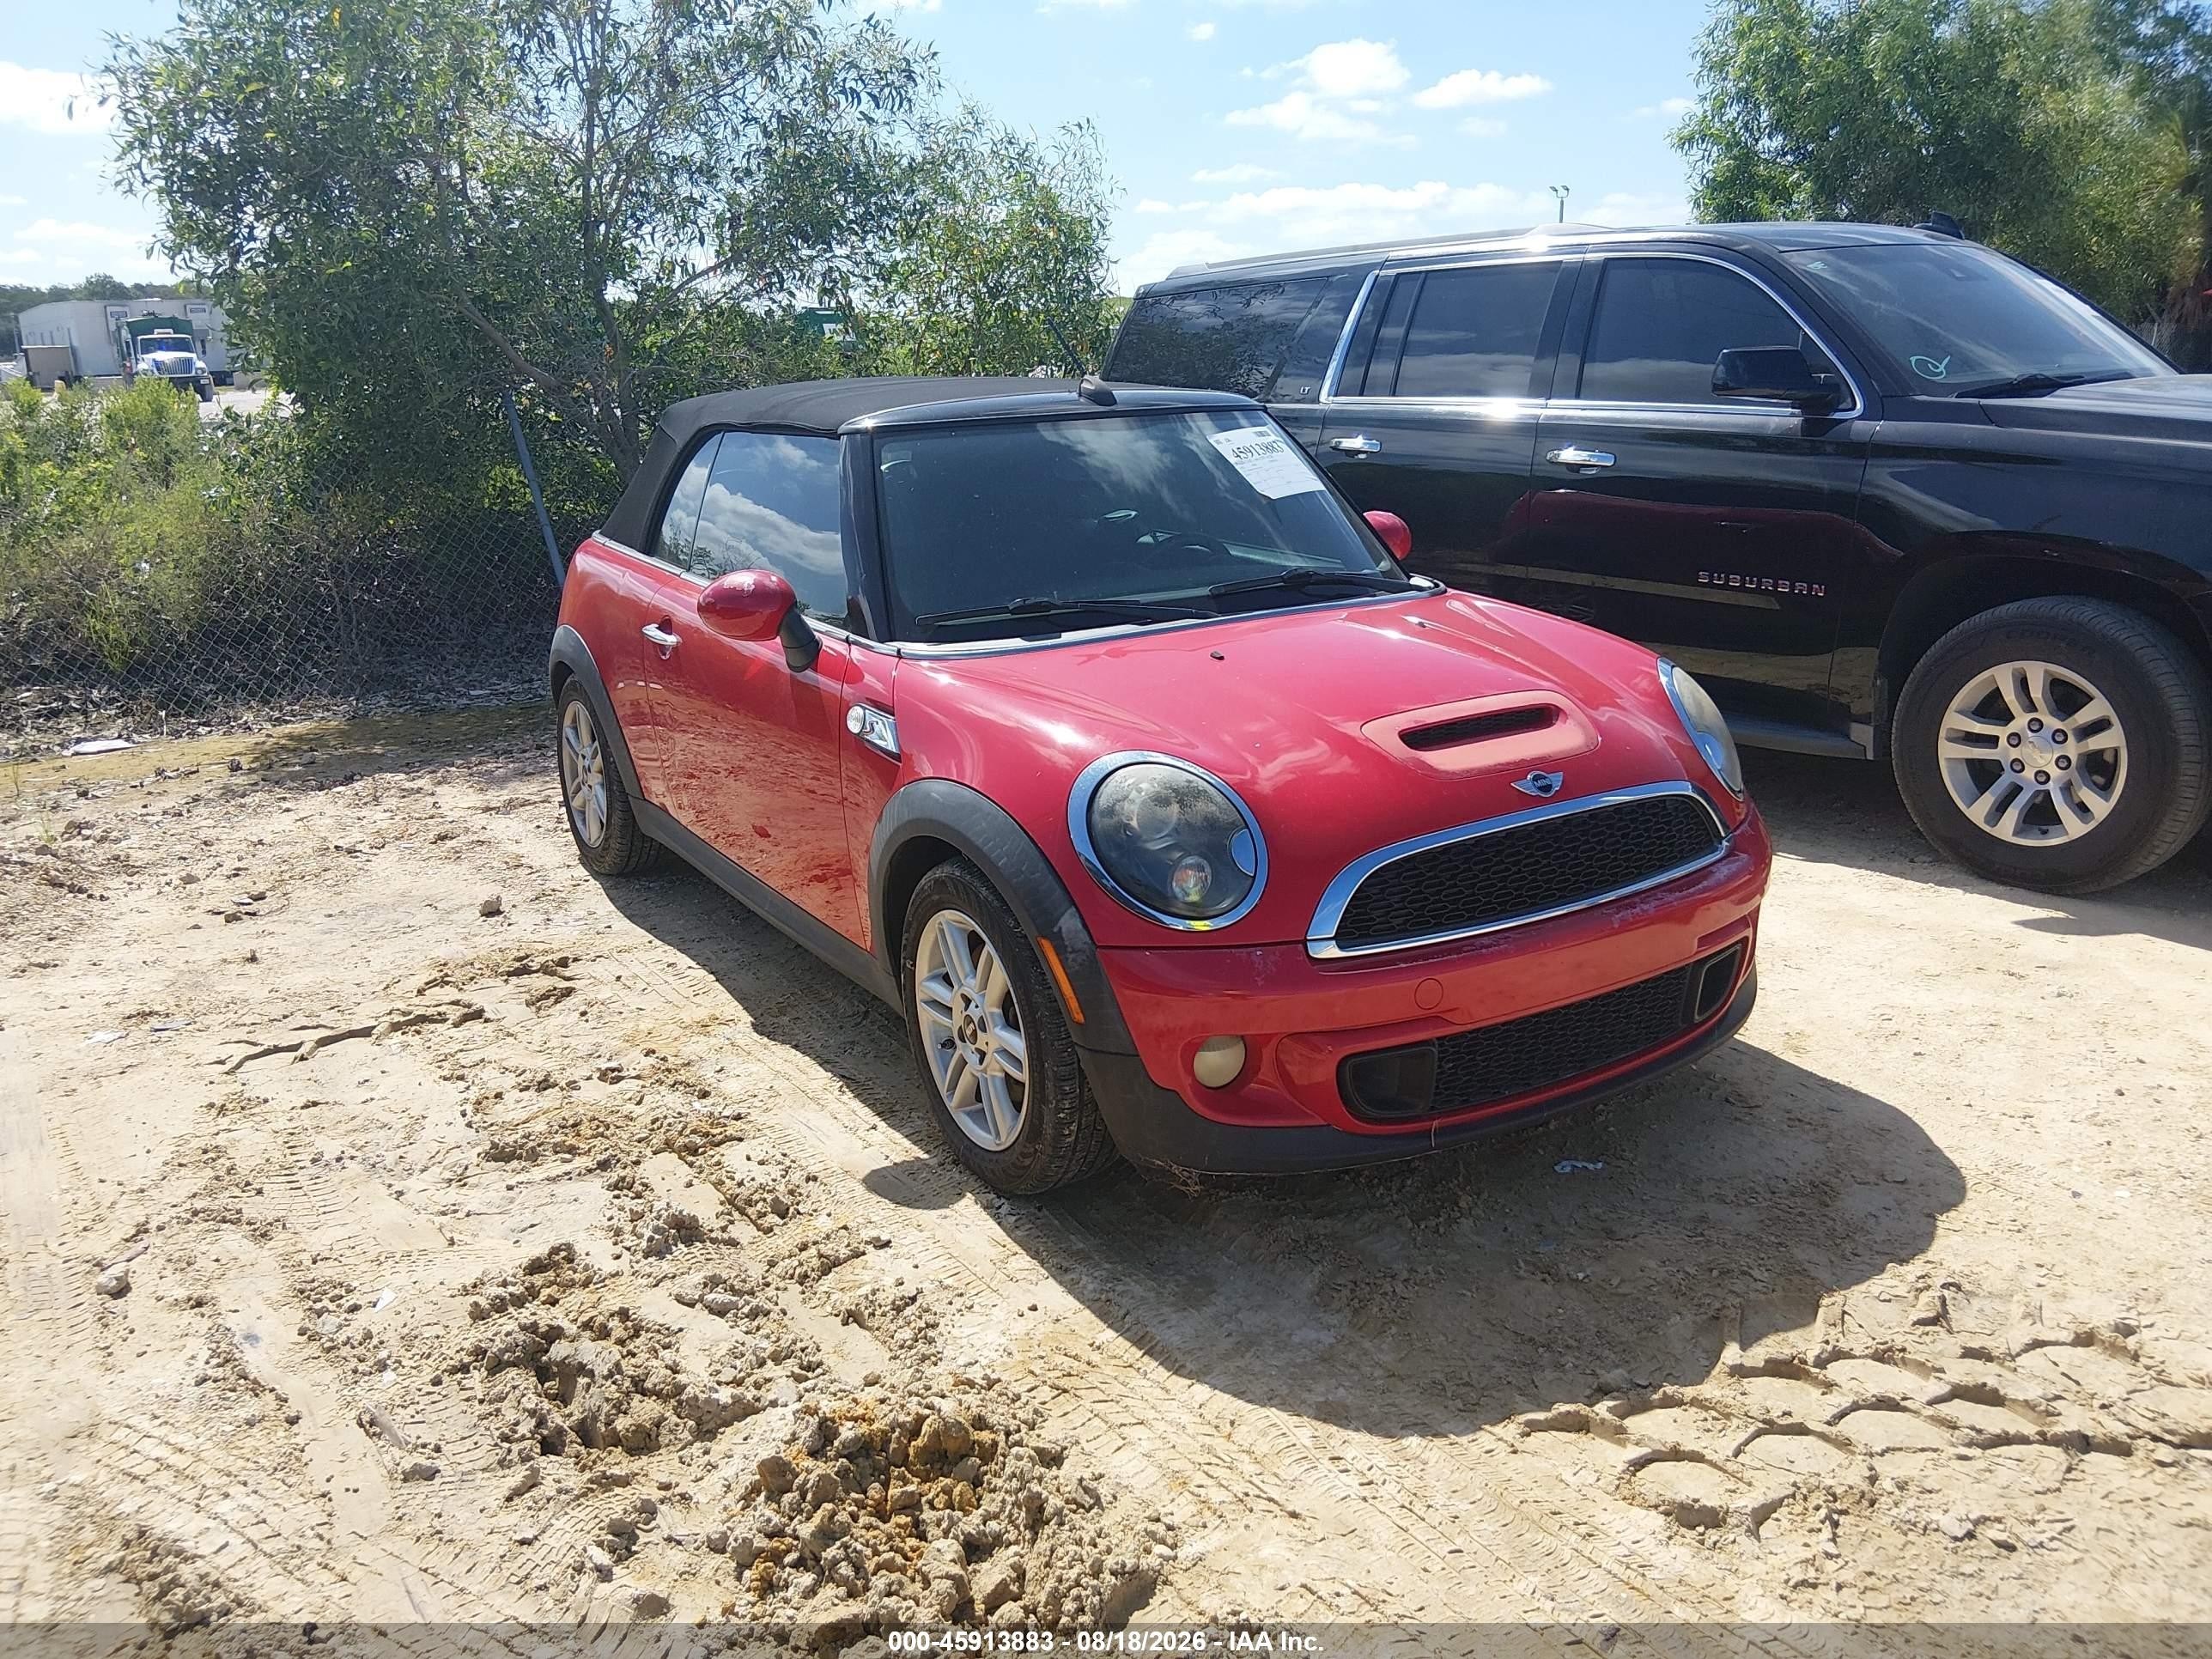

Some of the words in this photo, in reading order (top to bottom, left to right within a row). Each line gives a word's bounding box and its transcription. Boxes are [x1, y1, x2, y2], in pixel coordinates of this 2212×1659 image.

[1231, 441, 1285, 459] 45913883
[1697, 571, 1827, 597] SUBURBAN
[863, 720, 879, 736] S
[1534, 778, 1552, 787] MINI
